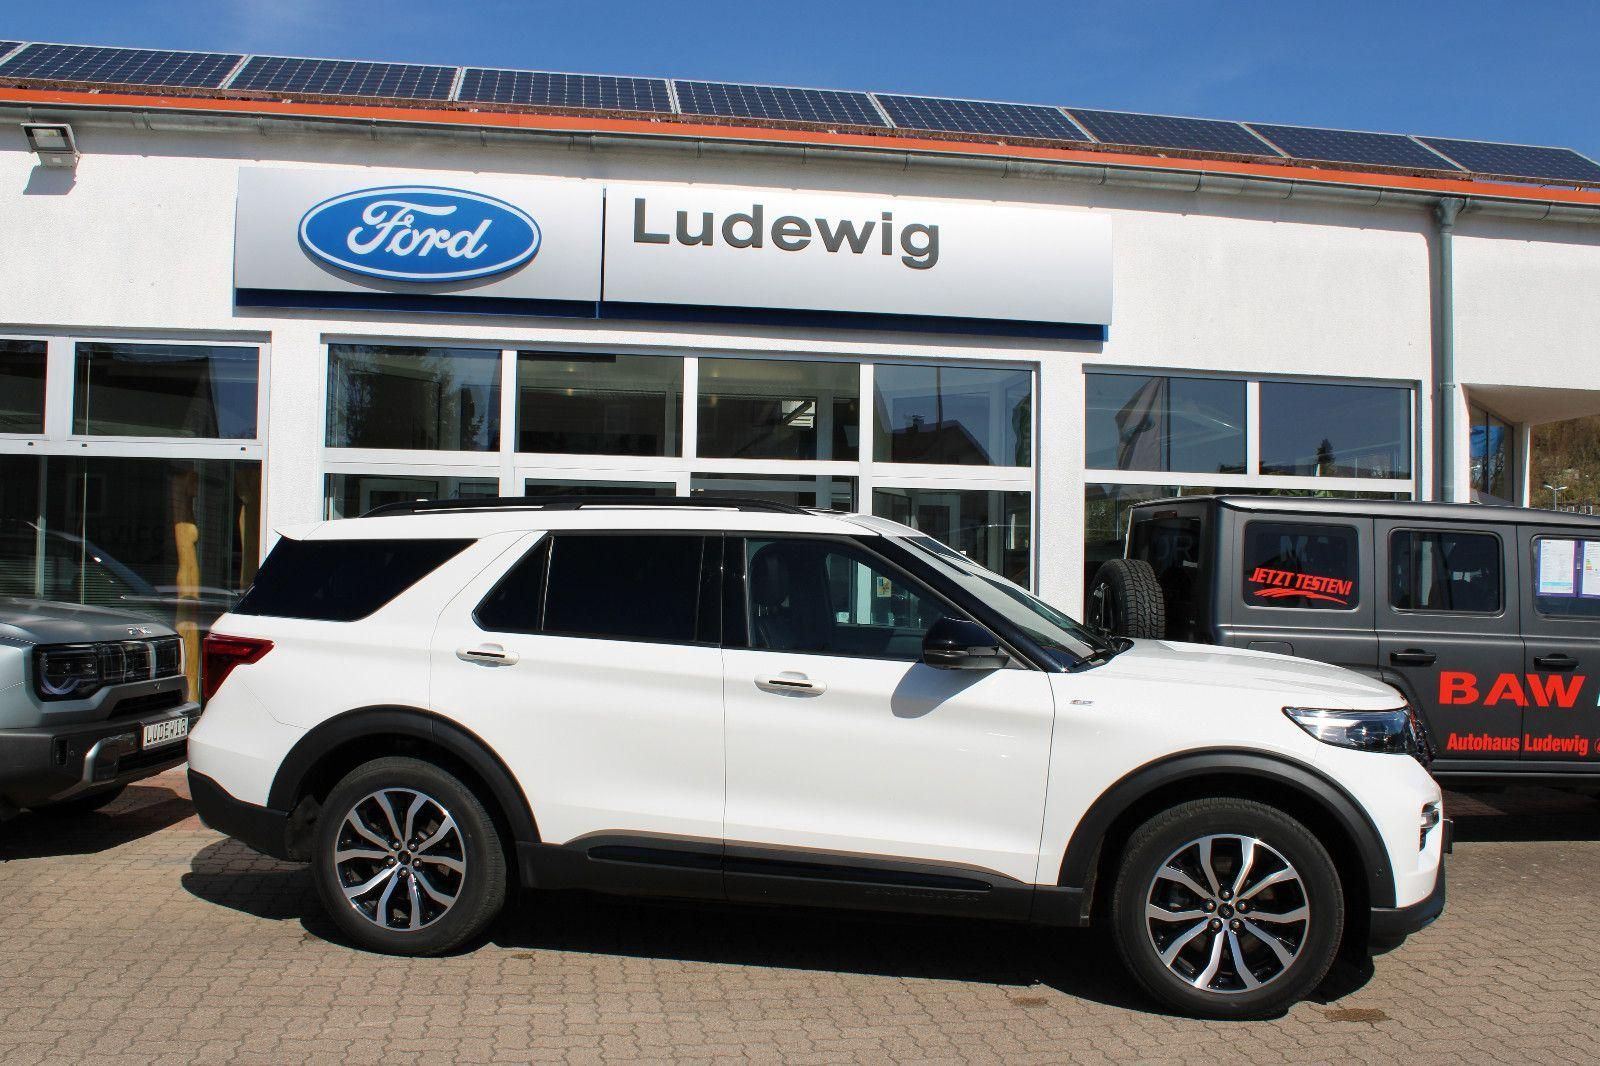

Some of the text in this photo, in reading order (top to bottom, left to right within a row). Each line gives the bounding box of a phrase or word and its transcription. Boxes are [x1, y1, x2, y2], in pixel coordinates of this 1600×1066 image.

[346, 199, 493, 260] Ford
[633, 197, 941, 270] Ludewig
[1248, 567, 1295, 587] JETZT
[1438, 671, 1586, 708] BAW
[1446, 732, 1520, 751] Autohaus
[1524, 733, 1589, 756] Ludewig
